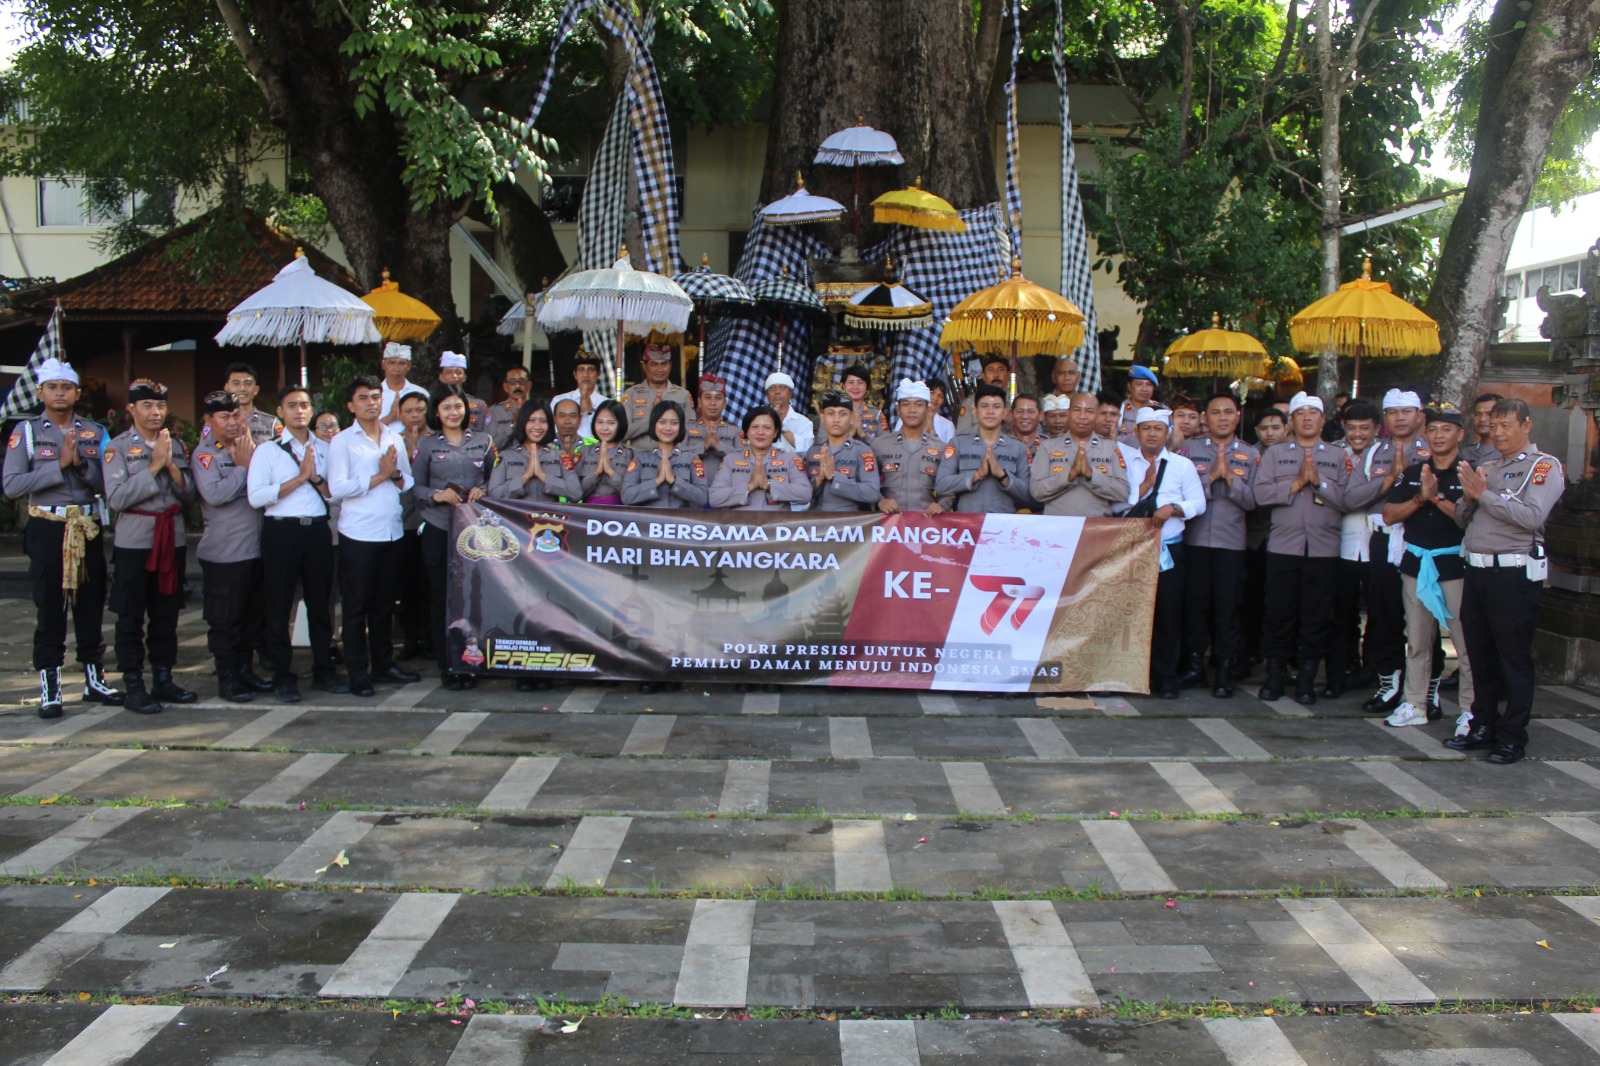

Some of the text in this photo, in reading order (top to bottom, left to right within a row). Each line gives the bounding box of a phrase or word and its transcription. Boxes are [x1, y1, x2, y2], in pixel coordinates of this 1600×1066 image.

[530, 512, 566, 520] BALI
[586, 519, 976, 546] DOA BERSAMA DALAM RANGKA
[586, 546, 840, 570] HARI BHAYANGKARA
[884, 570, 1045, 636] KE- 77
[490, 651, 596, 668] PRESISI
[723, 643, 1003, 660] POLRI PRESISI UNTUK NEGERI
[671, 656, 1060, 677] PEMILU DAMAI MENUJU INDONESIA EMAS
